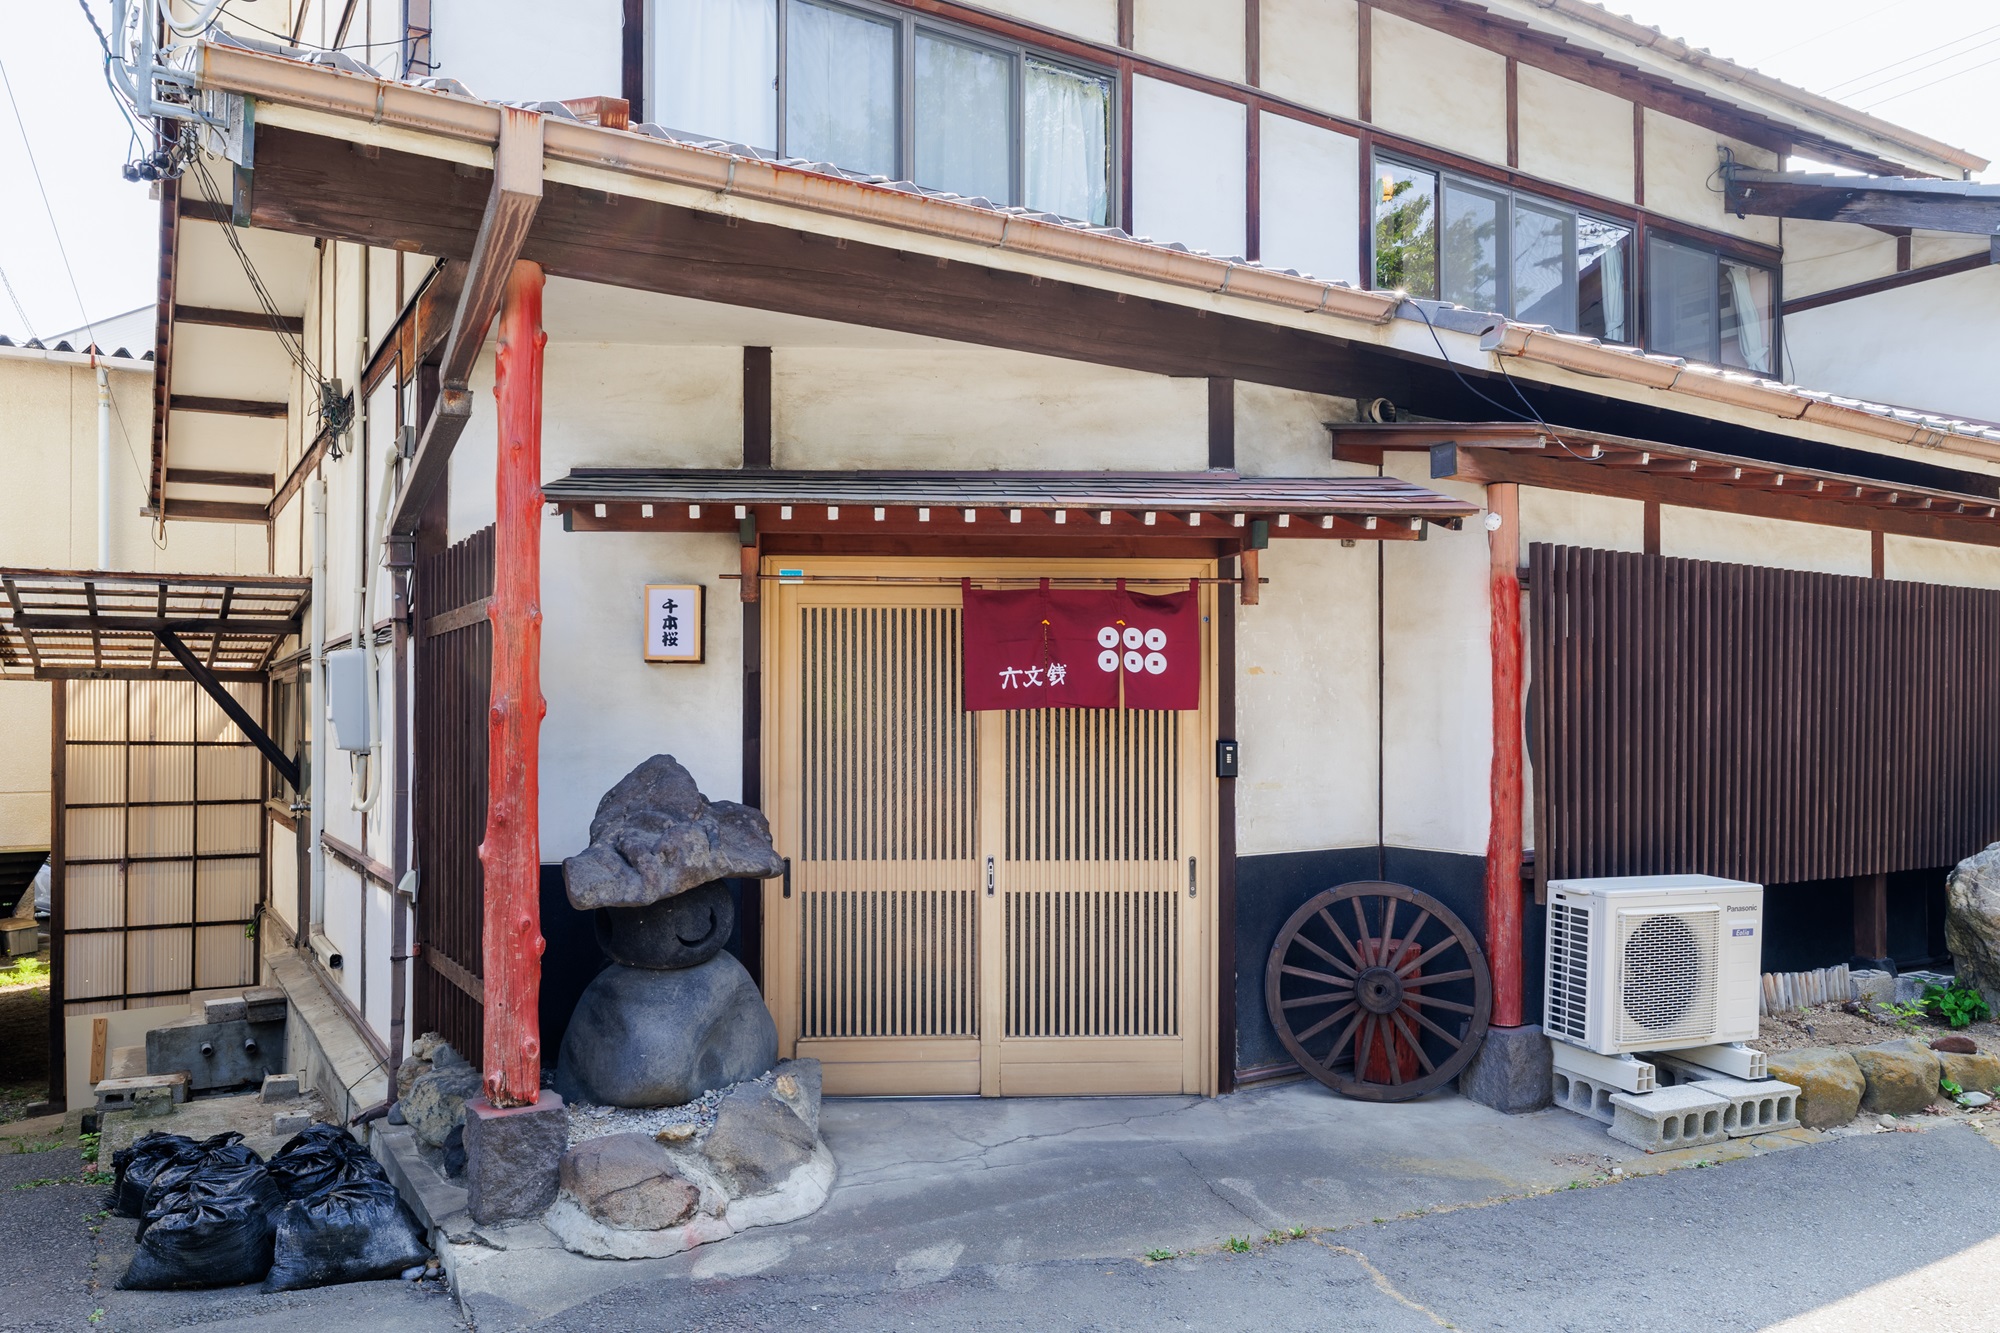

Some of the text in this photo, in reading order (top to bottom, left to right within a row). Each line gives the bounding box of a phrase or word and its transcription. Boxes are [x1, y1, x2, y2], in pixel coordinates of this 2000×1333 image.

[662, 598, 678, 647] 千本桜
[999, 662, 1067, 689] 六文銭
[1726, 904, 1758, 912] Panasonic
